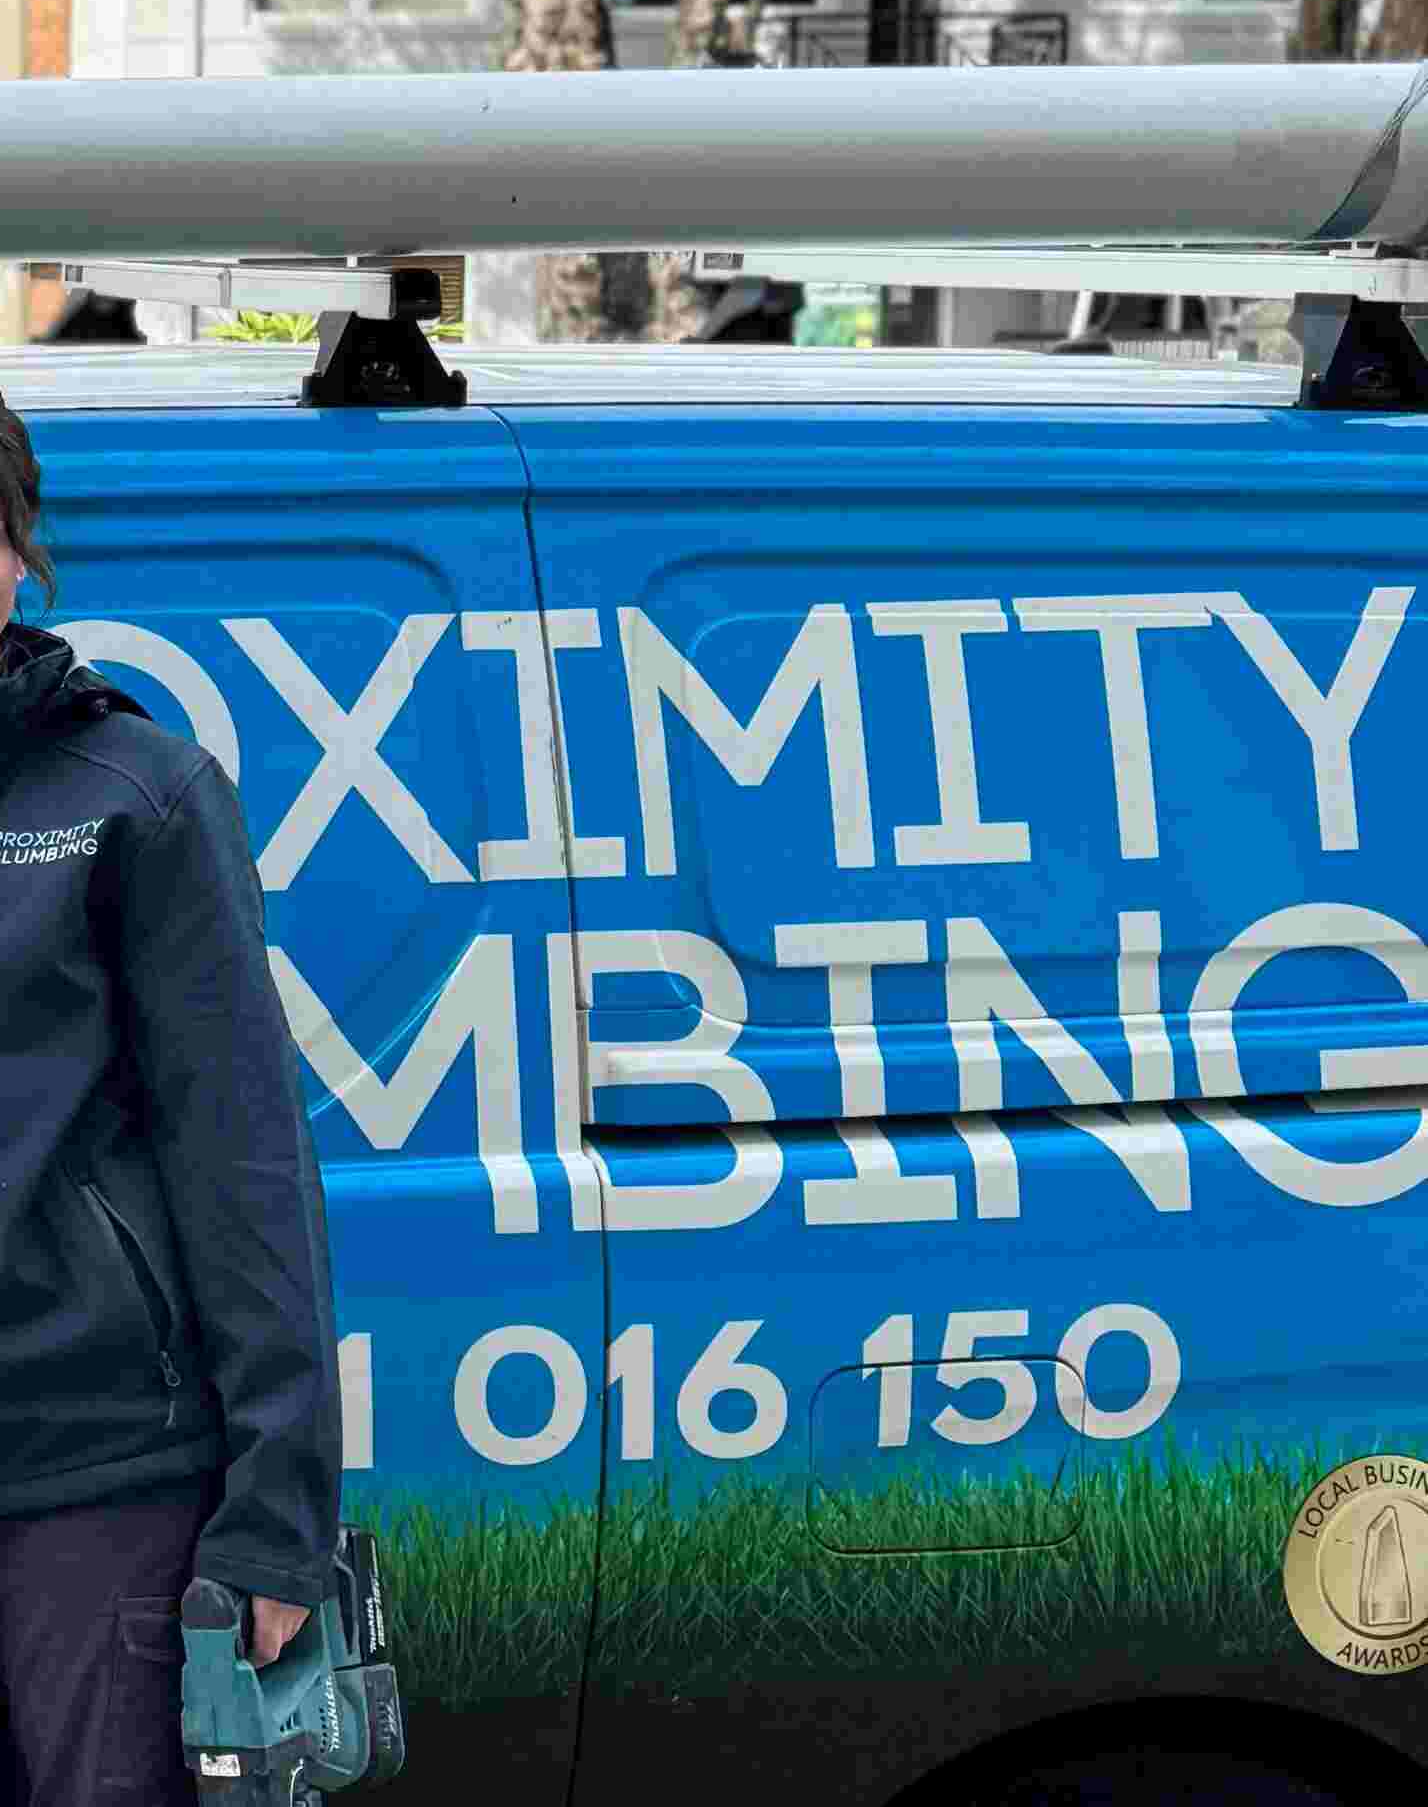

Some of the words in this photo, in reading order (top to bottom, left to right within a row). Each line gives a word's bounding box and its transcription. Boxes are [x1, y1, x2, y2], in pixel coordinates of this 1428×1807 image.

[452, 1318, 790, 1466] 016
[860, 1303, 1183, 1447] 150
[1298, 1474, 1360, 1540] LOCAL
